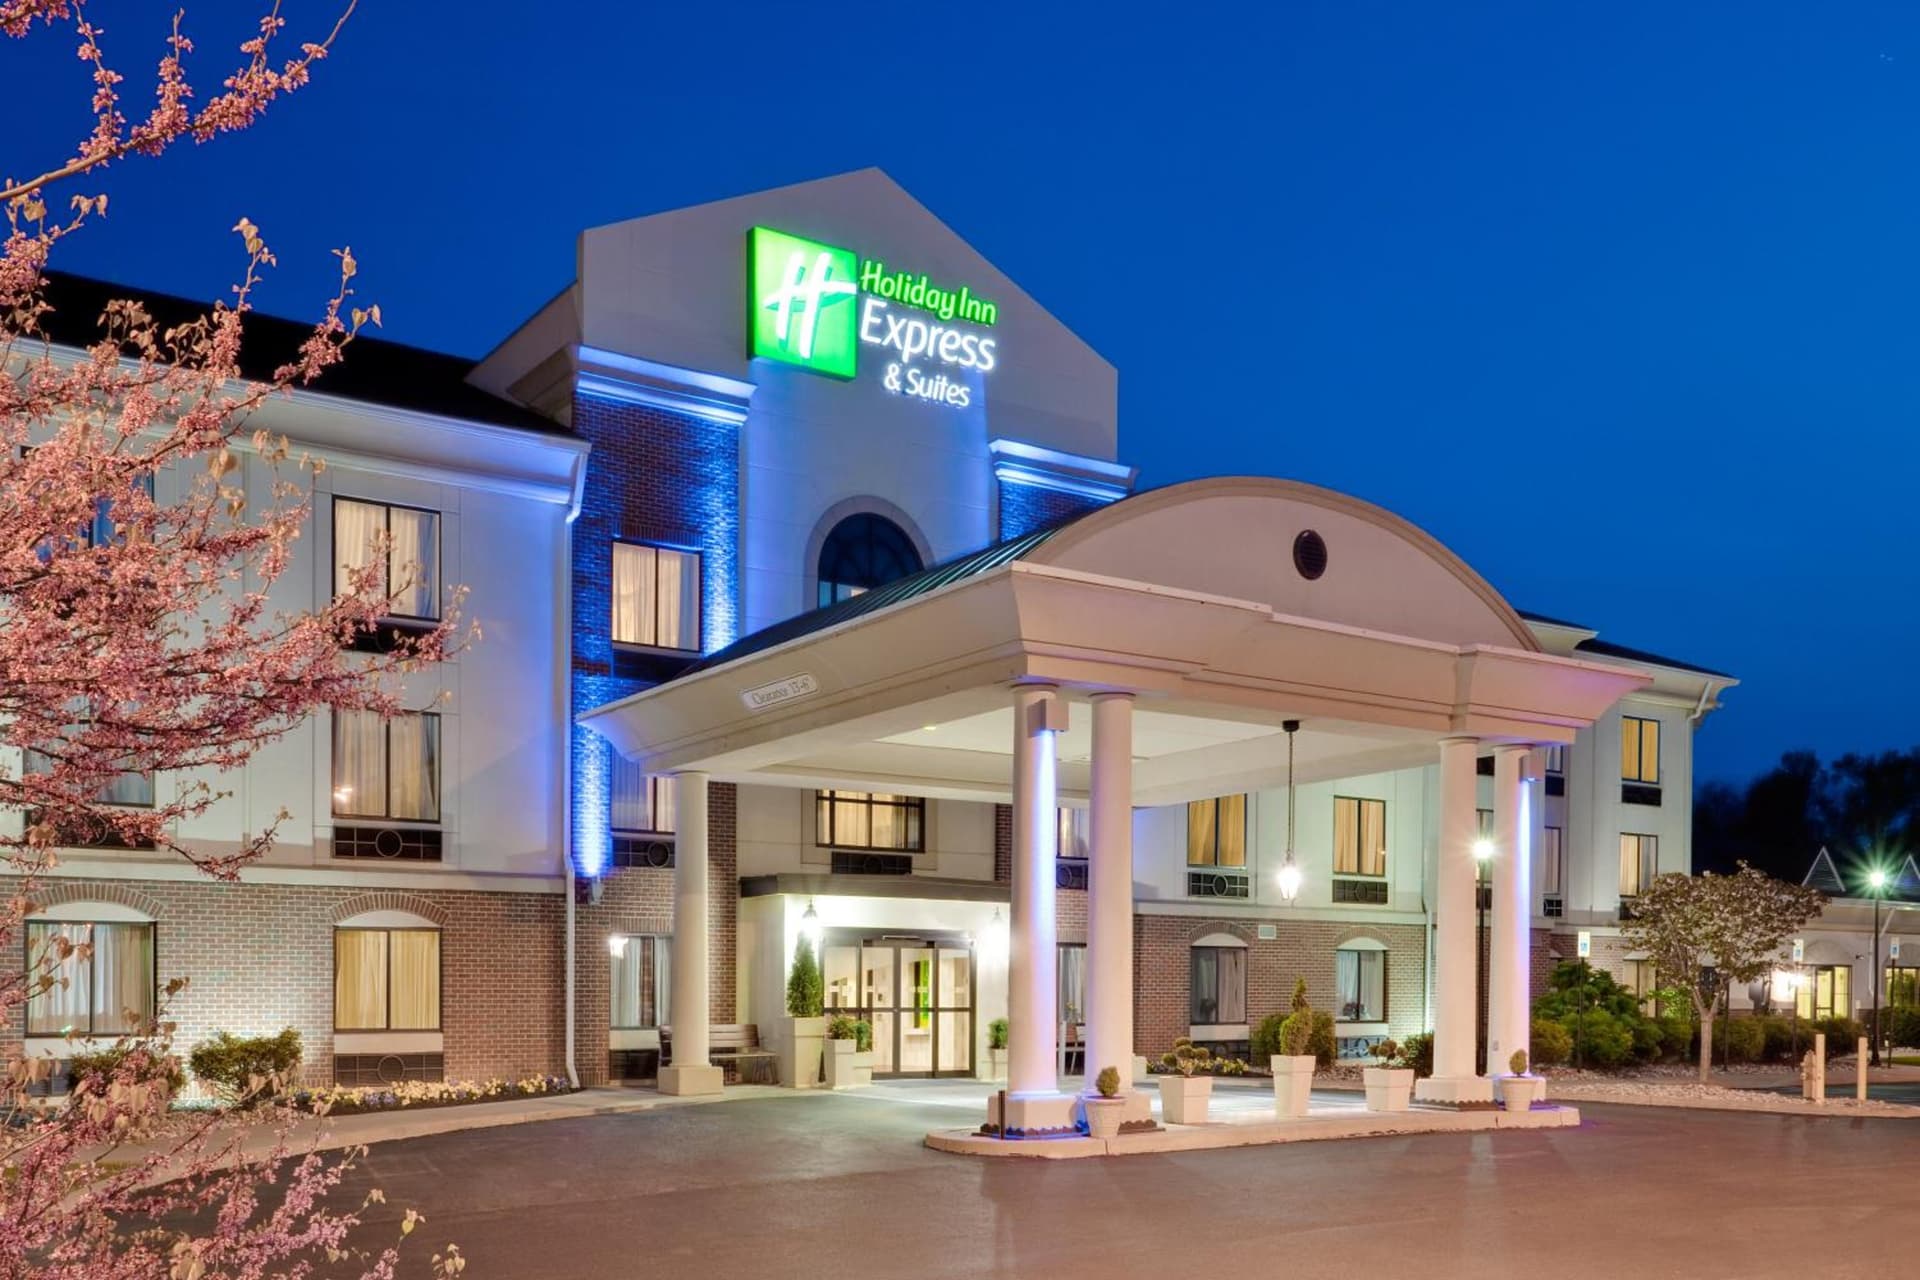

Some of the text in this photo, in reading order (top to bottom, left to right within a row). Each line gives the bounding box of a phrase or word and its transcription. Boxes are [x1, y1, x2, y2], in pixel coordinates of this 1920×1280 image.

[860, 260, 996, 324] Holiday Inn
[860, 298, 996, 371] Express
[883, 362, 971, 407] & Suites
